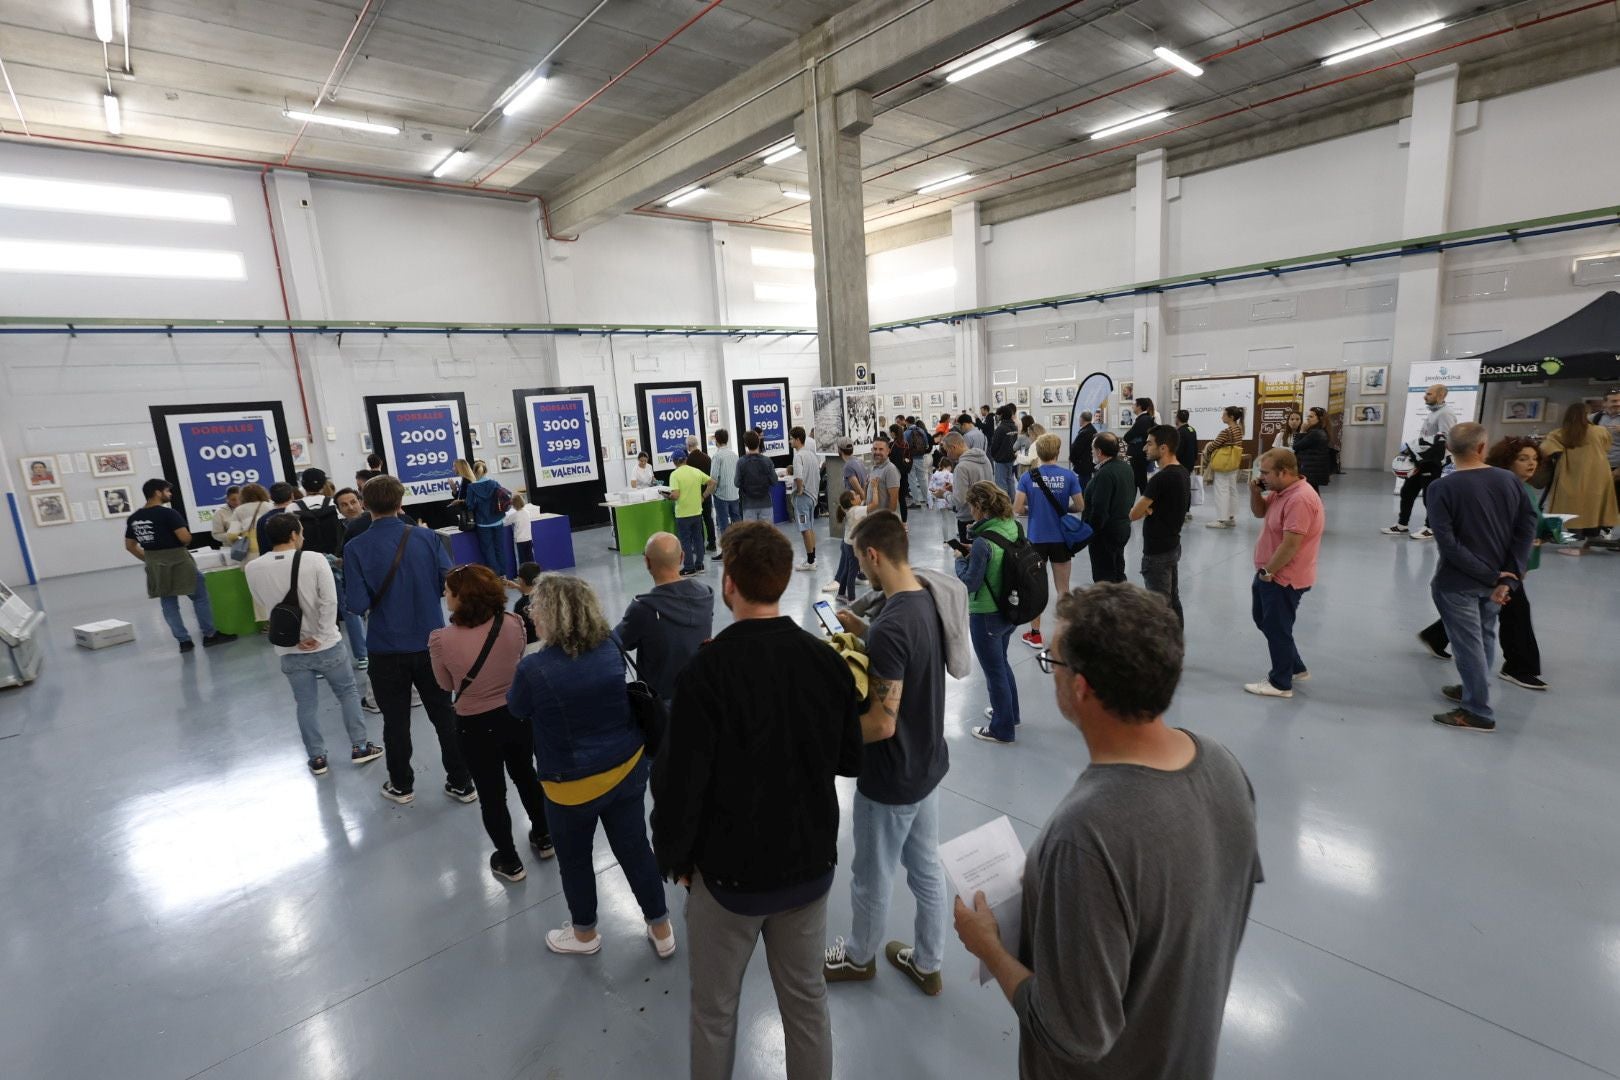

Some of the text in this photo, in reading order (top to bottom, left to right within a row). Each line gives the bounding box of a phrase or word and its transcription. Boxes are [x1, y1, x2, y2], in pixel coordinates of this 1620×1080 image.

[540, 403, 577, 412] DORSALES
[754, 404, 778, 414] 5000
[659, 410, 689, 421] 4000
[192, 423, 255, 436] DORSALES
[543, 418, 580, 432] 3000
[756, 420, 778, 430] 5999
[400, 428, 447, 444] 2000
[662, 428, 690, 440] 4999
[199, 443, 258, 460] 0001
[546, 438, 580, 452] 3999
[406, 451, 448, 467] 2999
[206, 469, 260, 486] 1999
[412, 480, 461, 496] VALENCA
